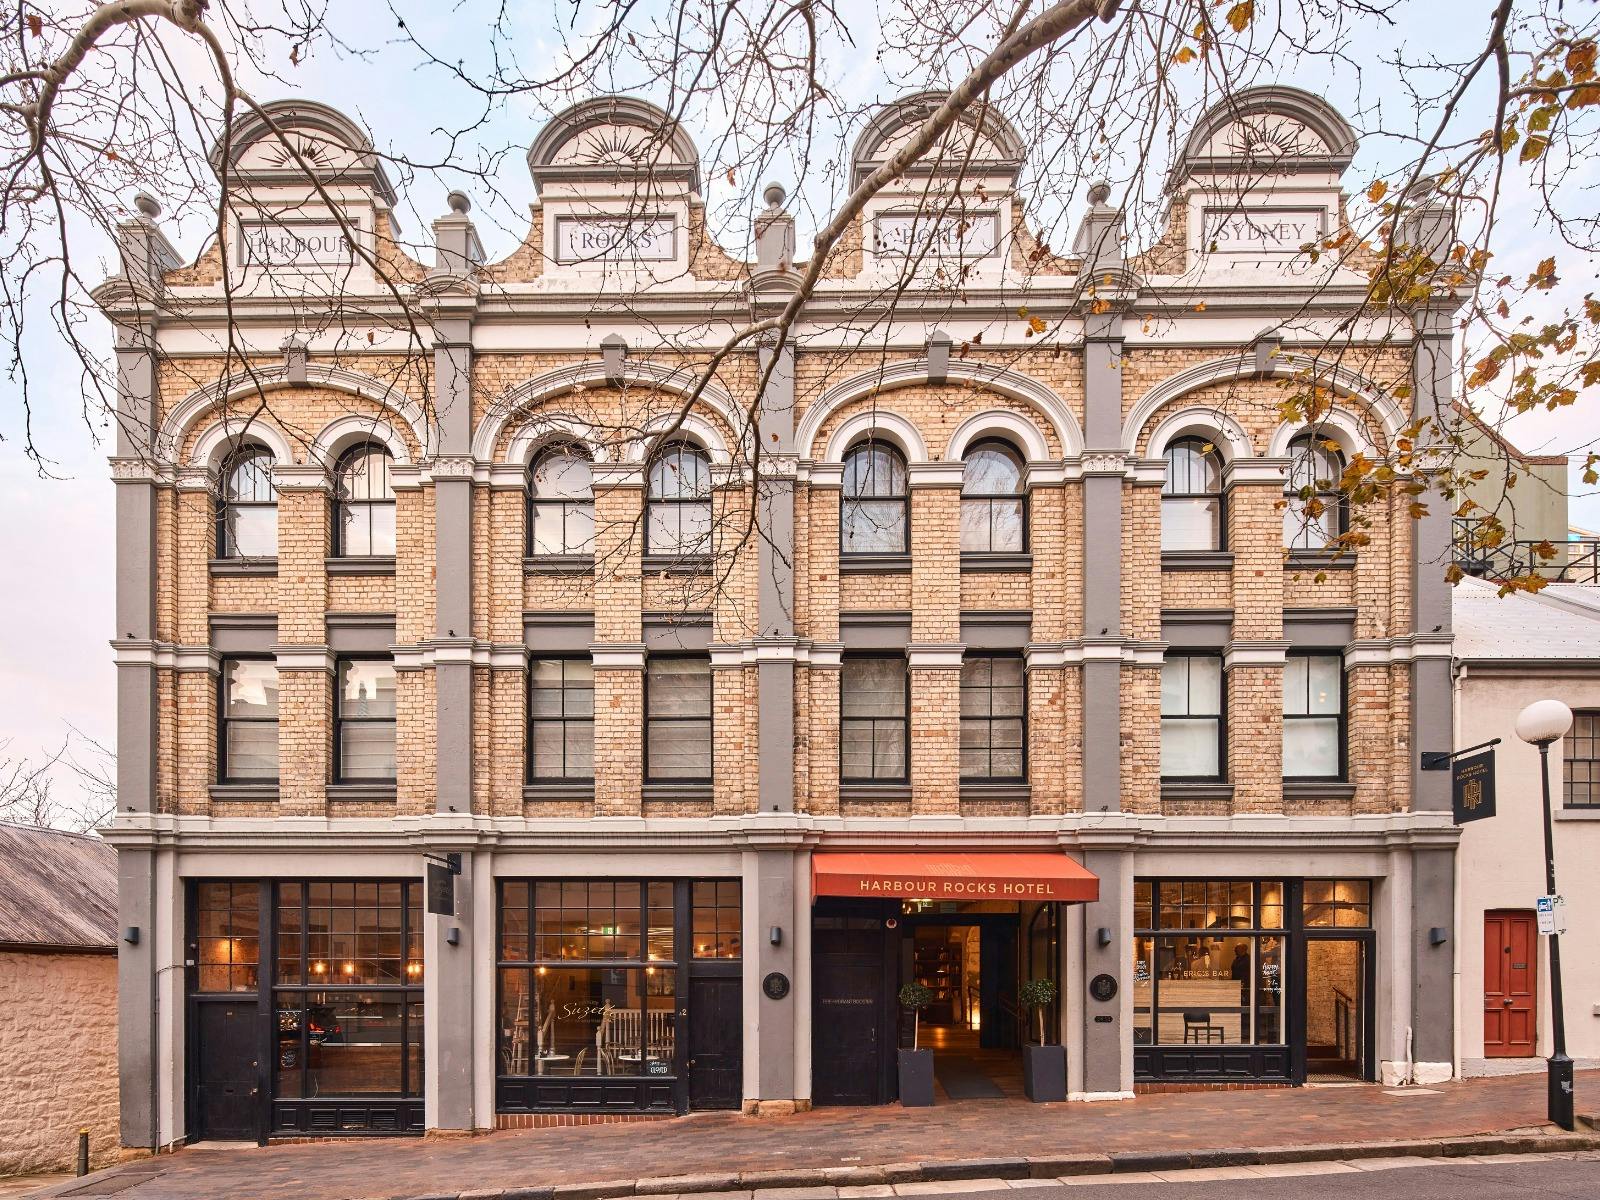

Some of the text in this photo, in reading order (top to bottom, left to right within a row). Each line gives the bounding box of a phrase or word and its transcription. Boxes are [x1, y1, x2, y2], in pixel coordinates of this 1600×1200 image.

[902, 228, 970, 244] HOTE
[1219, 223, 1306, 240] SYDNEY
[249, 236, 351, 253] HARBOUR
[581, 232, 652, 249] ROCKS
[860, 880, 1054, 894] HARBOUR ROCKS HOTEL
